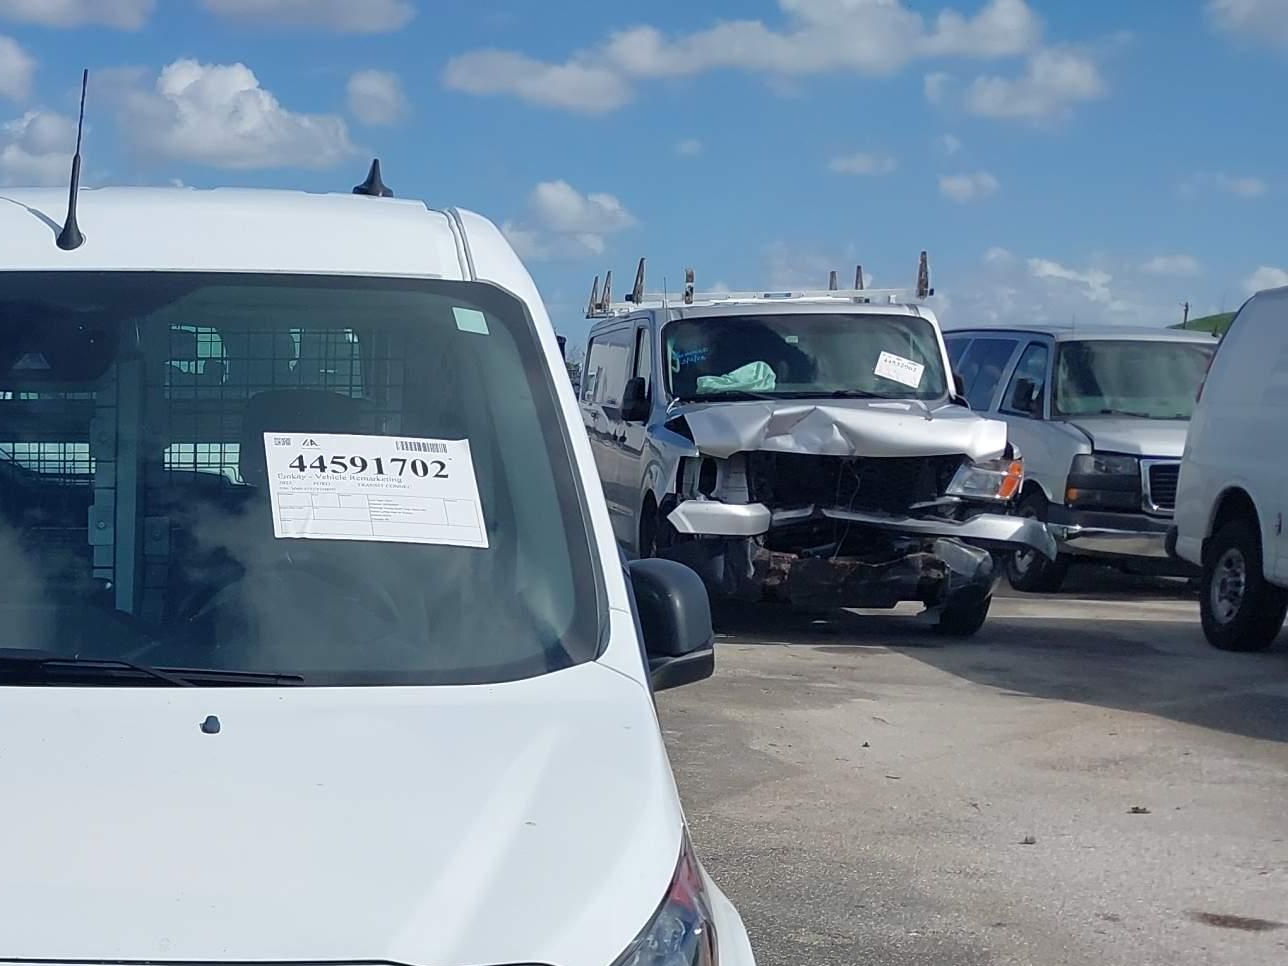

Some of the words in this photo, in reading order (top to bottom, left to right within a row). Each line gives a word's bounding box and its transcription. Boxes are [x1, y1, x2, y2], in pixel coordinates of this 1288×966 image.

[288, 454, 449, 479] 44591702
[314, 473, 347, 481] Vehicle
[349, 475, 403, 483] Remarketing
